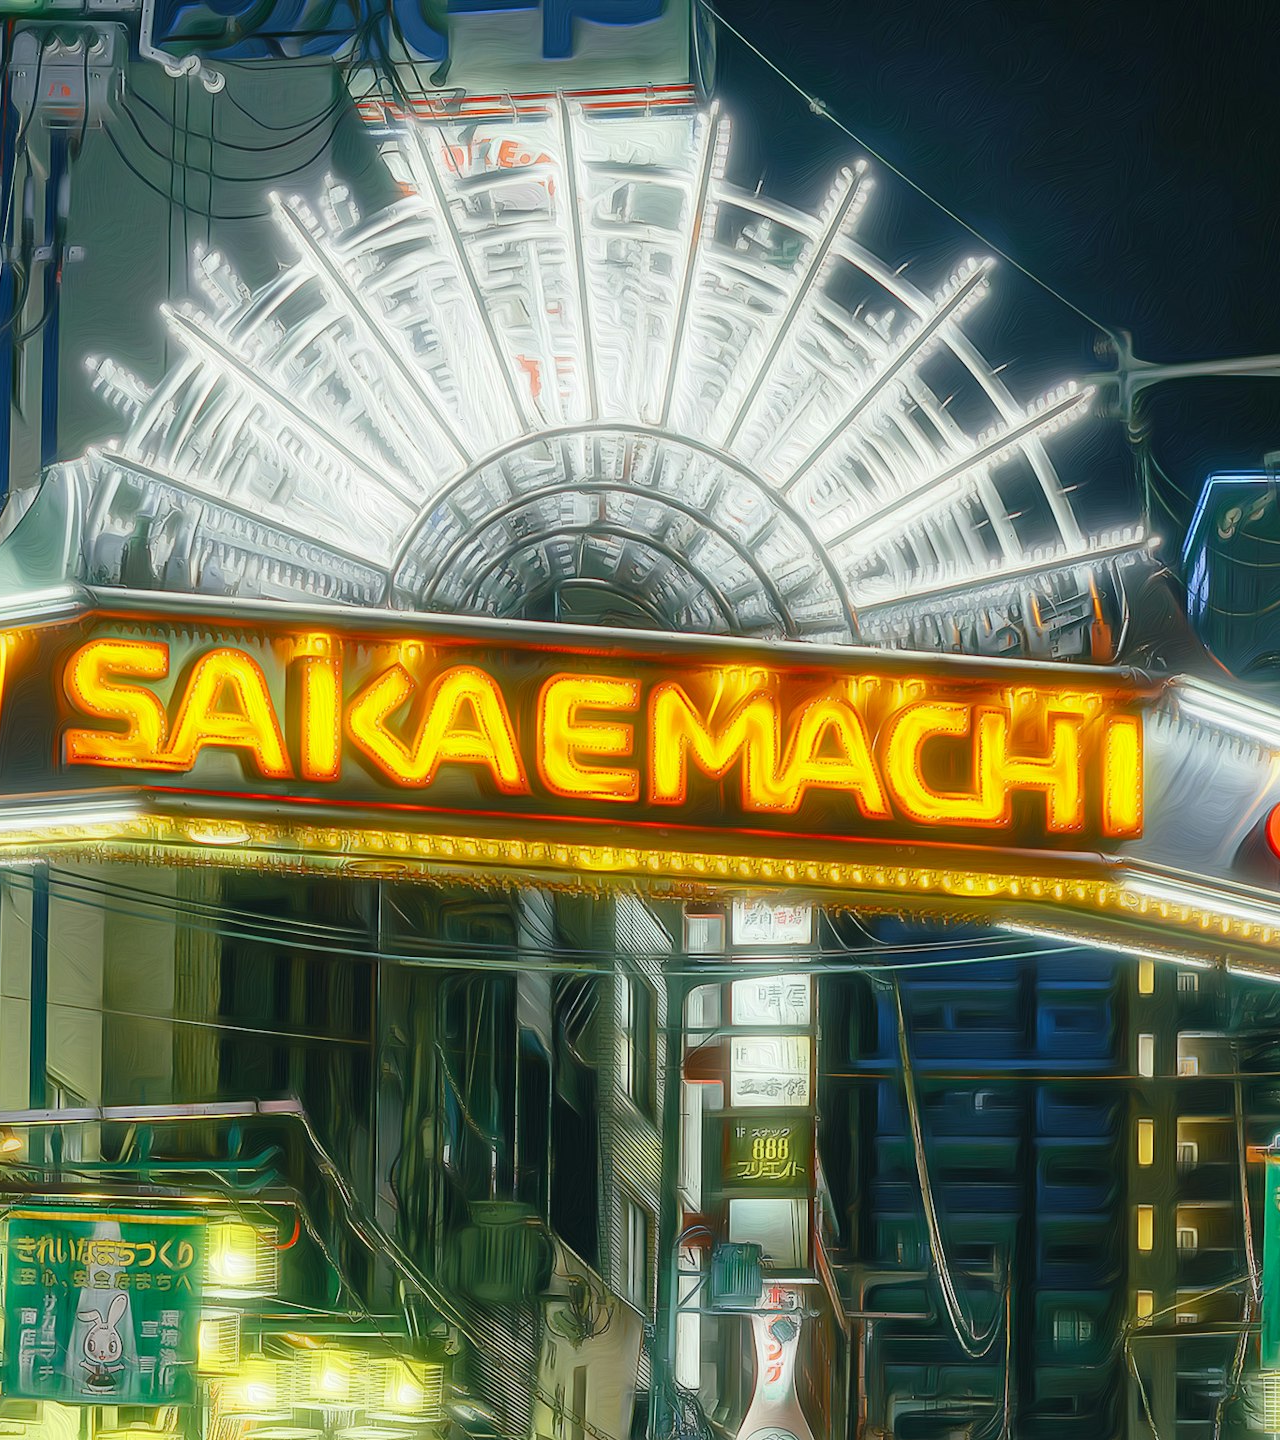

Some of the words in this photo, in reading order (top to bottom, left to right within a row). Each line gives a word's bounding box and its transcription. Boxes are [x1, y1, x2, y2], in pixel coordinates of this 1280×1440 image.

[62, 634, 1143, 840] SAKAEMACHI
[735, 1126, 746, 1138] 1F
[751, 1126, 791, 1138] スナック
[751, 1137, 790, 1160] 888
[15, 1235, 195, 1270] きれいなまちづくり
